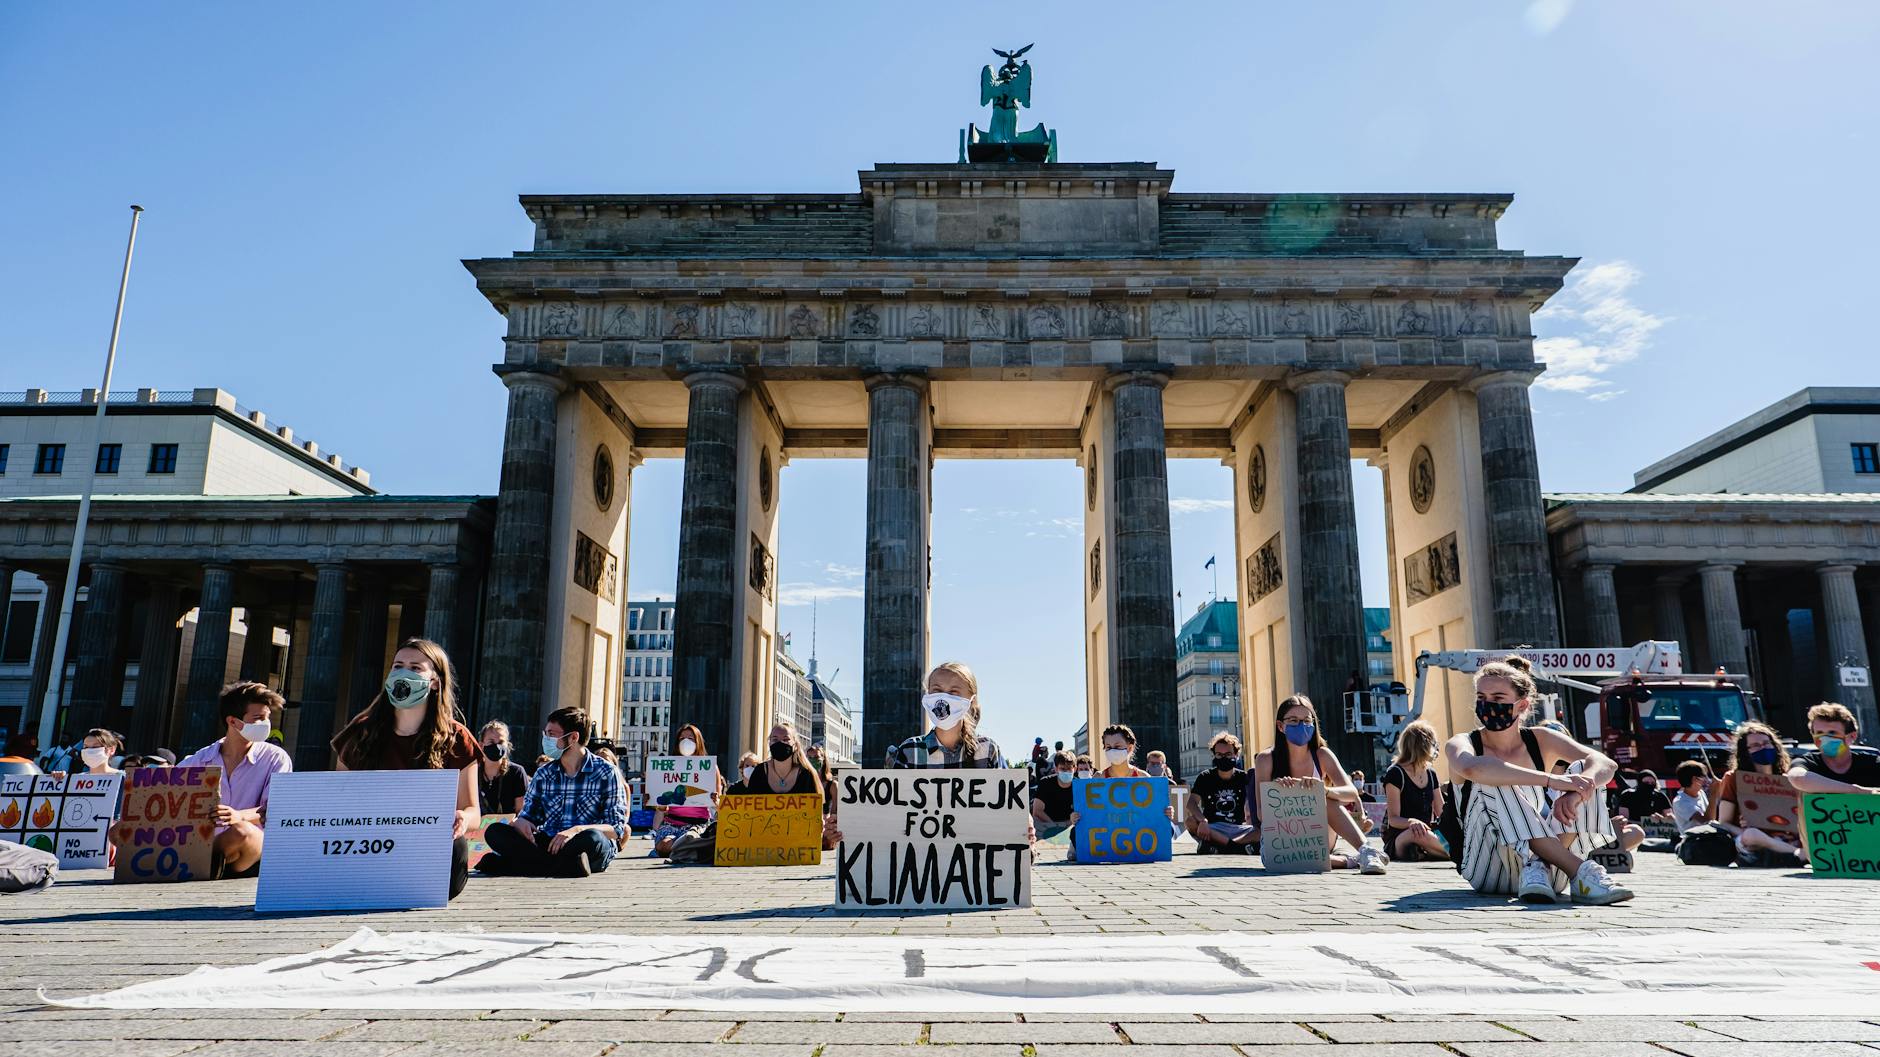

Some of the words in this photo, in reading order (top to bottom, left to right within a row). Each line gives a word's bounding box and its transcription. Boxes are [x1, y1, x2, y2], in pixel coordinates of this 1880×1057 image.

[1542, 653, 1568, 668] 530
[1573, 653, 1591, 668] 00
[1596, 653, 1616, 668] 03
[651, 759, 676, 771] THERE
[686, 759, 693, 771] IS
[699, 759, 711, 771] NO
[133, 767, 206, 788] MAKE
[663, 772, 690, 783] PLANET
[693, 773, 699, 783] B
[6, 781, 24, 792] TIC
[40, 781, 63, 791] TAC
[841, 775, 1026, 809] SKOLSTREJK
[1085, 781, 1153, 809] ECO
[72, 803, 83, 820] B
[121, 791, 213, 822] LOVE
[719, 795, 821, 811] APFELSAFT
[1273, 807, 1316, 818] CHANGE
[280, 819, 305, 827] FACE
[308, 818, 327, 827] THE
[330, 817, 373, 826] CLIMATE
[376, 816, 440, 825] EMERGENCY
[723, 812, 820, 838] STATT
[905, 809, 956, 839] FÖR
[65, 839, 80, 847] NO
[134, 825, 193, 847] NOT
[1088, 827, 1158, 857] EGO
[1271, 836, 1324, 850] CLIMATE
[1813, 824, 1852, 845] not
[64, 849, 98, 858] PLANET
[322, 839, 395, 855] 127.309
[716, 846, 817, 862] KOHLEKRAFT
[1273, 848, 1326, 865] CHANGE!
[1813, 848, 1880, 873] Silen
[838, 841, 1030, 905] KLIMATET
